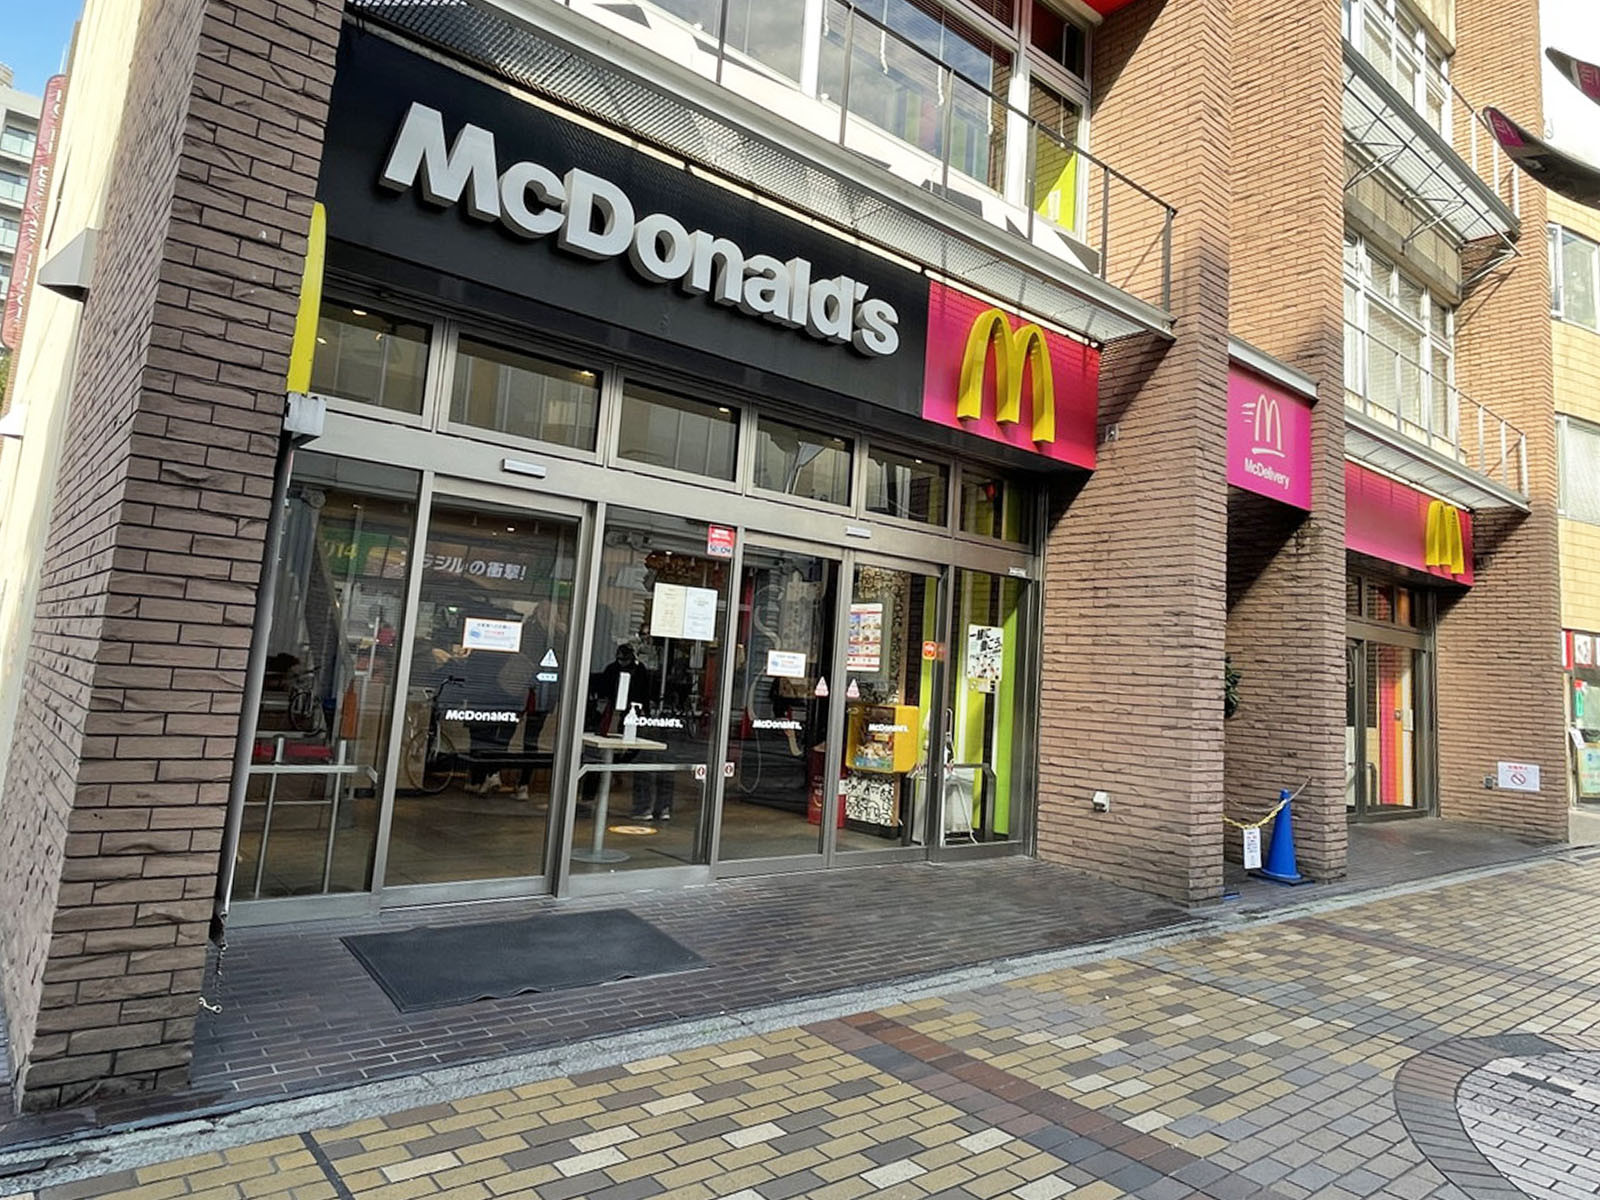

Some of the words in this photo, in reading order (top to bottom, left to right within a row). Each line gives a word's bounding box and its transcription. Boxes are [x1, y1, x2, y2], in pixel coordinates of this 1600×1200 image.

[381, 101, 899, 356] McDonald's
[1244, 457, 1290, 490] McDelivery
[445, 709, 520, 722] McDonald's
[752, 719, 802, 730] McDonald's
